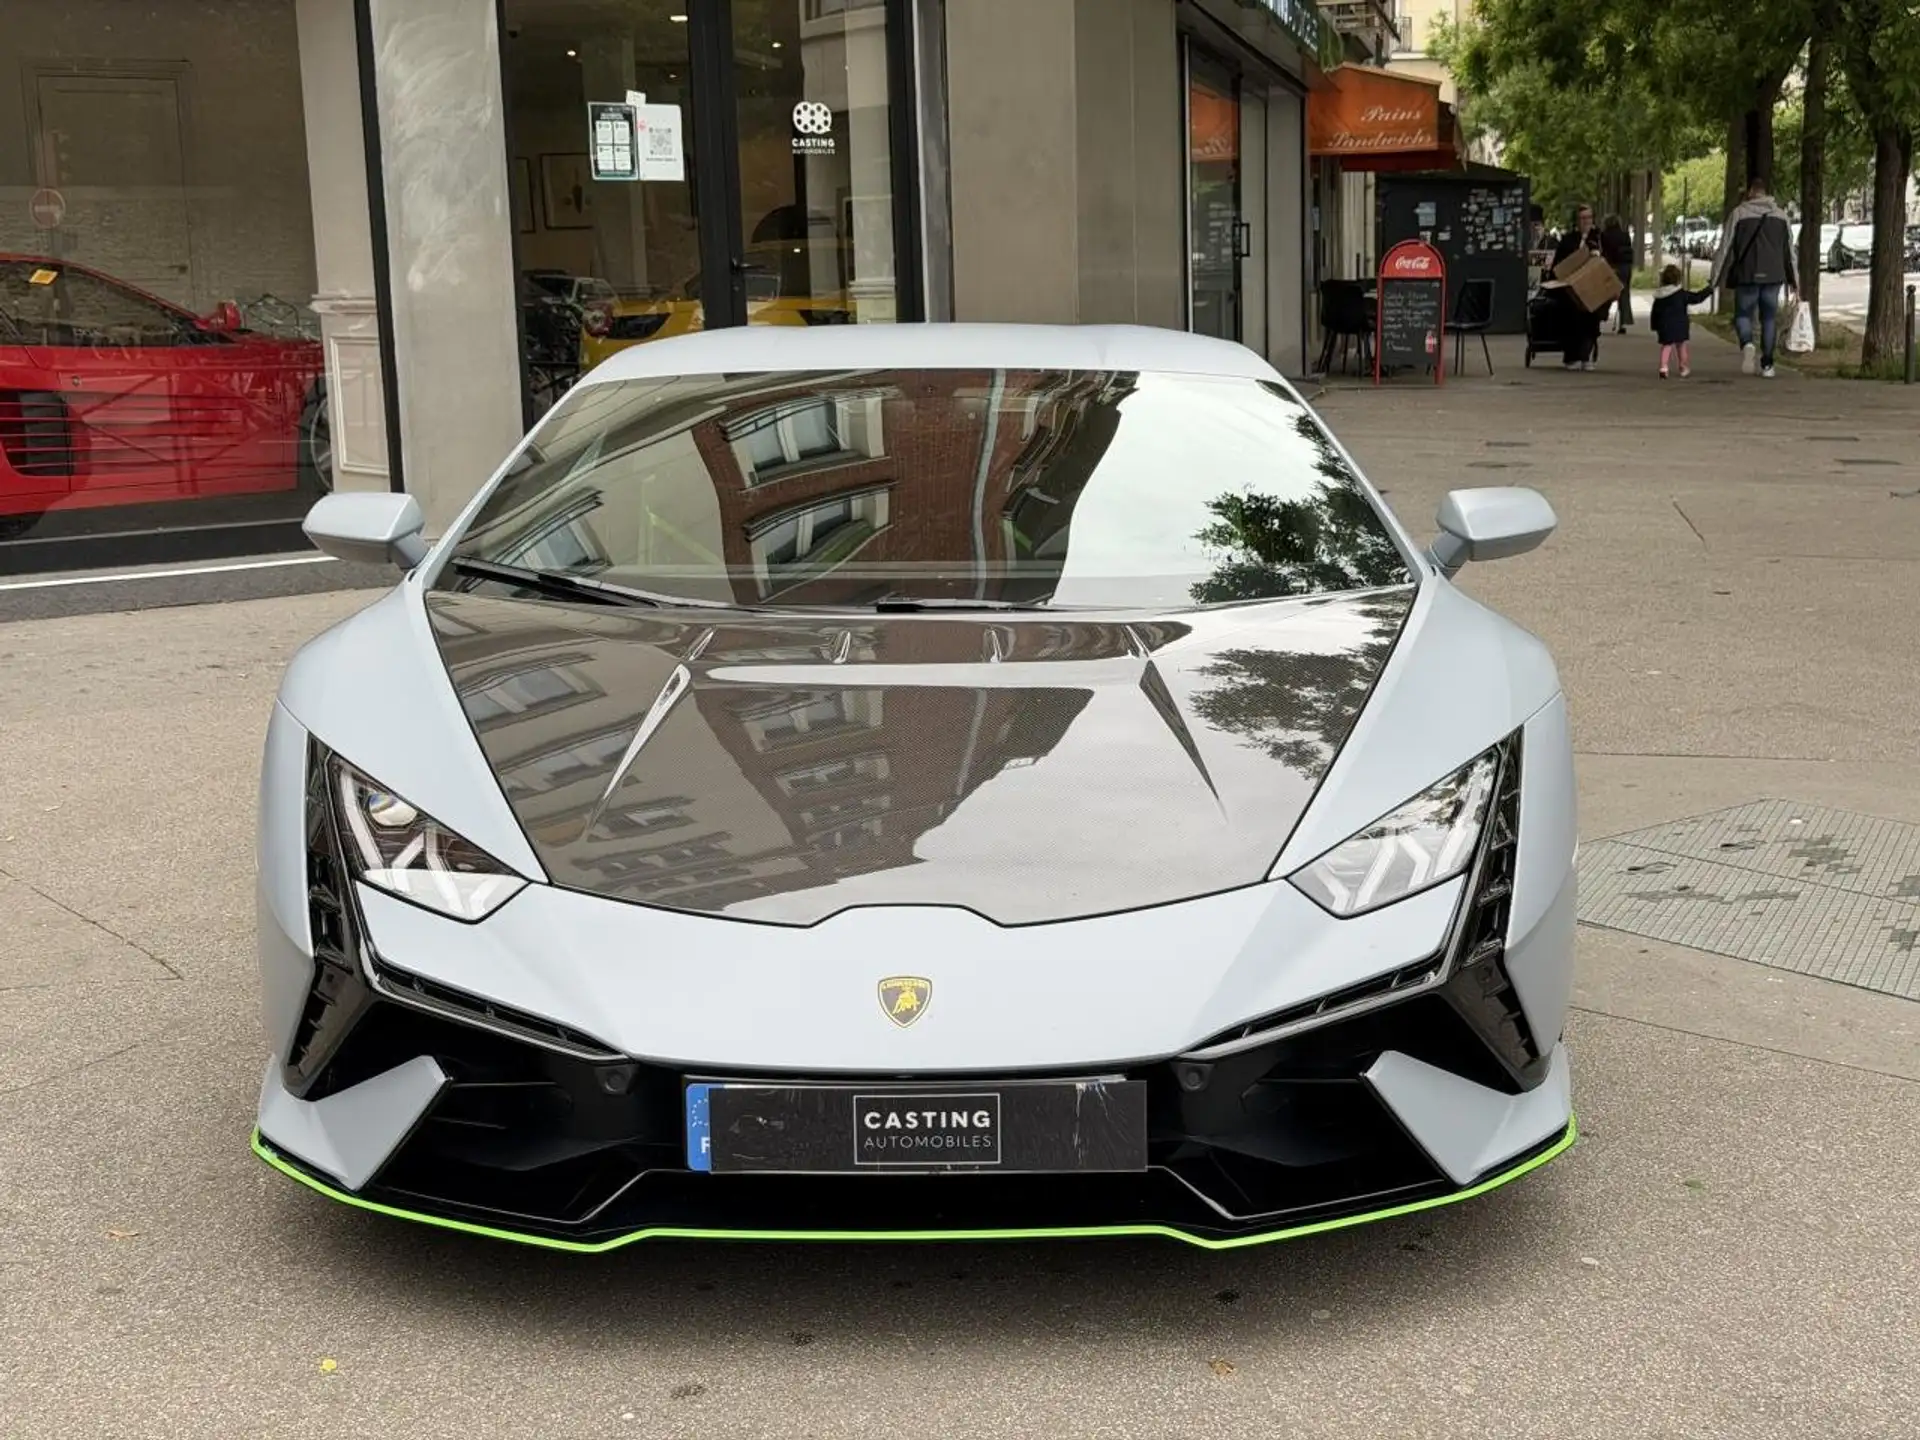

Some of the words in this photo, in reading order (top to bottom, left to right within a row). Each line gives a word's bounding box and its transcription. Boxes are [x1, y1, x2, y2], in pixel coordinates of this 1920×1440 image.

[1360, 104, 1422, 122] Pains
[792, 138, 835, 148] CASTING
[863, 1110, 991, 1129] CASTING
[701, 1136, 710, 1153] F
[863, 1135, 992, 1150] AUTOMOBILES
